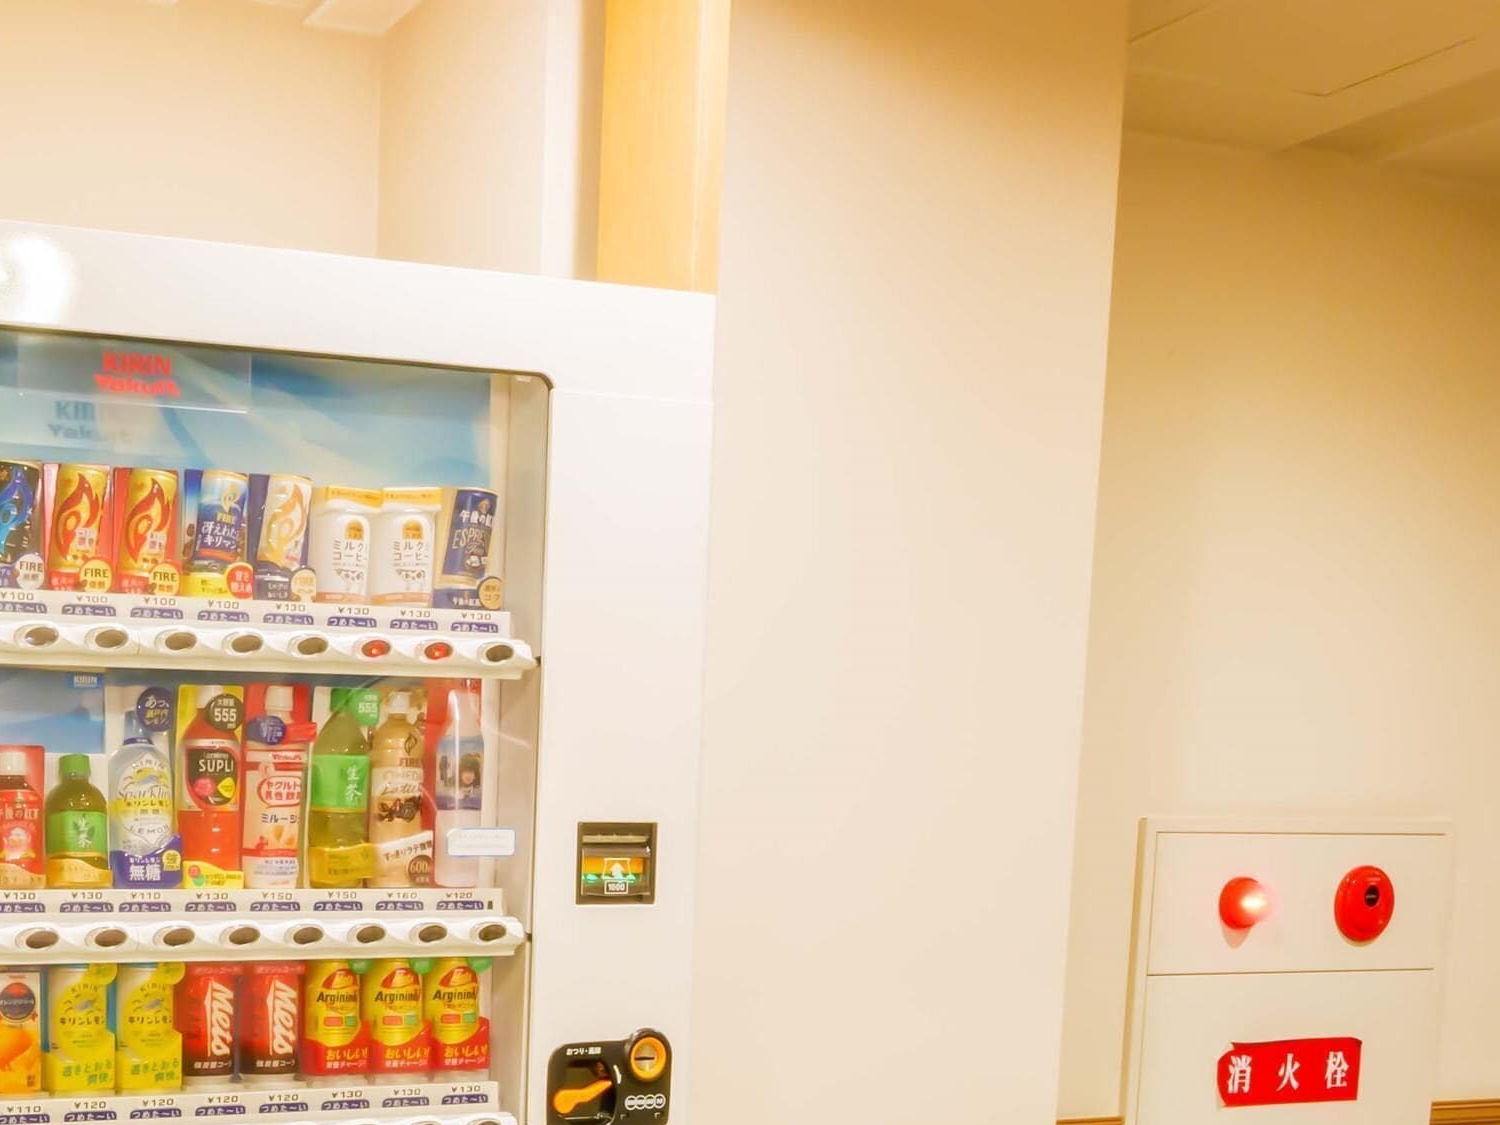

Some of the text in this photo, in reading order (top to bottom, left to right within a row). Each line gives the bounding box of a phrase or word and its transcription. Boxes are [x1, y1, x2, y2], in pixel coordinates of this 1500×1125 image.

[103, 349, 172, 376] KIRIN
[93, 373, 181, 397] Yakult
[332, 540, 365, 551] ミルク
[392, 541, 425, 552] ミルク
[19, 560, 44, 573] FIRE
[83, 567, 109, 579] FIRE
[152, 571, 178, 583] FIRE
[0, 591, 35, 601] ¥100
[76, 595, 108, 604] ¥100
[144, 597, 177, 607] ¥100
[208, 600, 240, 610] ¥100
[275, 602, 306, 613] ¥130
[338, 606, 370, 615] ¥130
[400, 609, 431, 618] ¥130
[461, 612, 492, 621] ¥130
[358, 702, 377, 714] 555
[213, 707, 237, 722] 555
[198, 759, 234, 773] SUPLI
[265, 779, 301, 790] ヤクルト
[346, 765, 362, 802] 生茶
[129, 864, 162, 882] 無糖
[3, 892, 36, 900] ¥130
[71, 892, 103, 900] ¥130
[131, 892, 161, 900] ¥110
[196, 892, 229, 900] ¥130
[262, 892, 292, 901] ¥150
[328, 891, 357, 899] ¥150
[387, 891, 418, 899] ¥160
[446, 891, 473, 899] ¥120
[211, 979, 235, 1056] Mets
[273, 979, 298, 1055] Mets
[1226, 1050, 1350, 1094] 消火栓
[332, 1090, 363, 1098] ¥130
[393, 1088, 421, 1096] ¥130
[451, 1085, 481, 1093] ¥130
[142, 1098, 175, 1107] ¥120
[208, 1095, 239, 1104] ¥120
[268, 1093, 299, 1102] ¥120
[7, 1105, 41, 1113] ¥110
[74, 1101, 107, 1109] ¥120
[66, 1111, 115, 1121] つめた〜い
[132, 1108, 180, 1118] つめた〜い
[197, 1106, 244, 1116] つめた〜い
